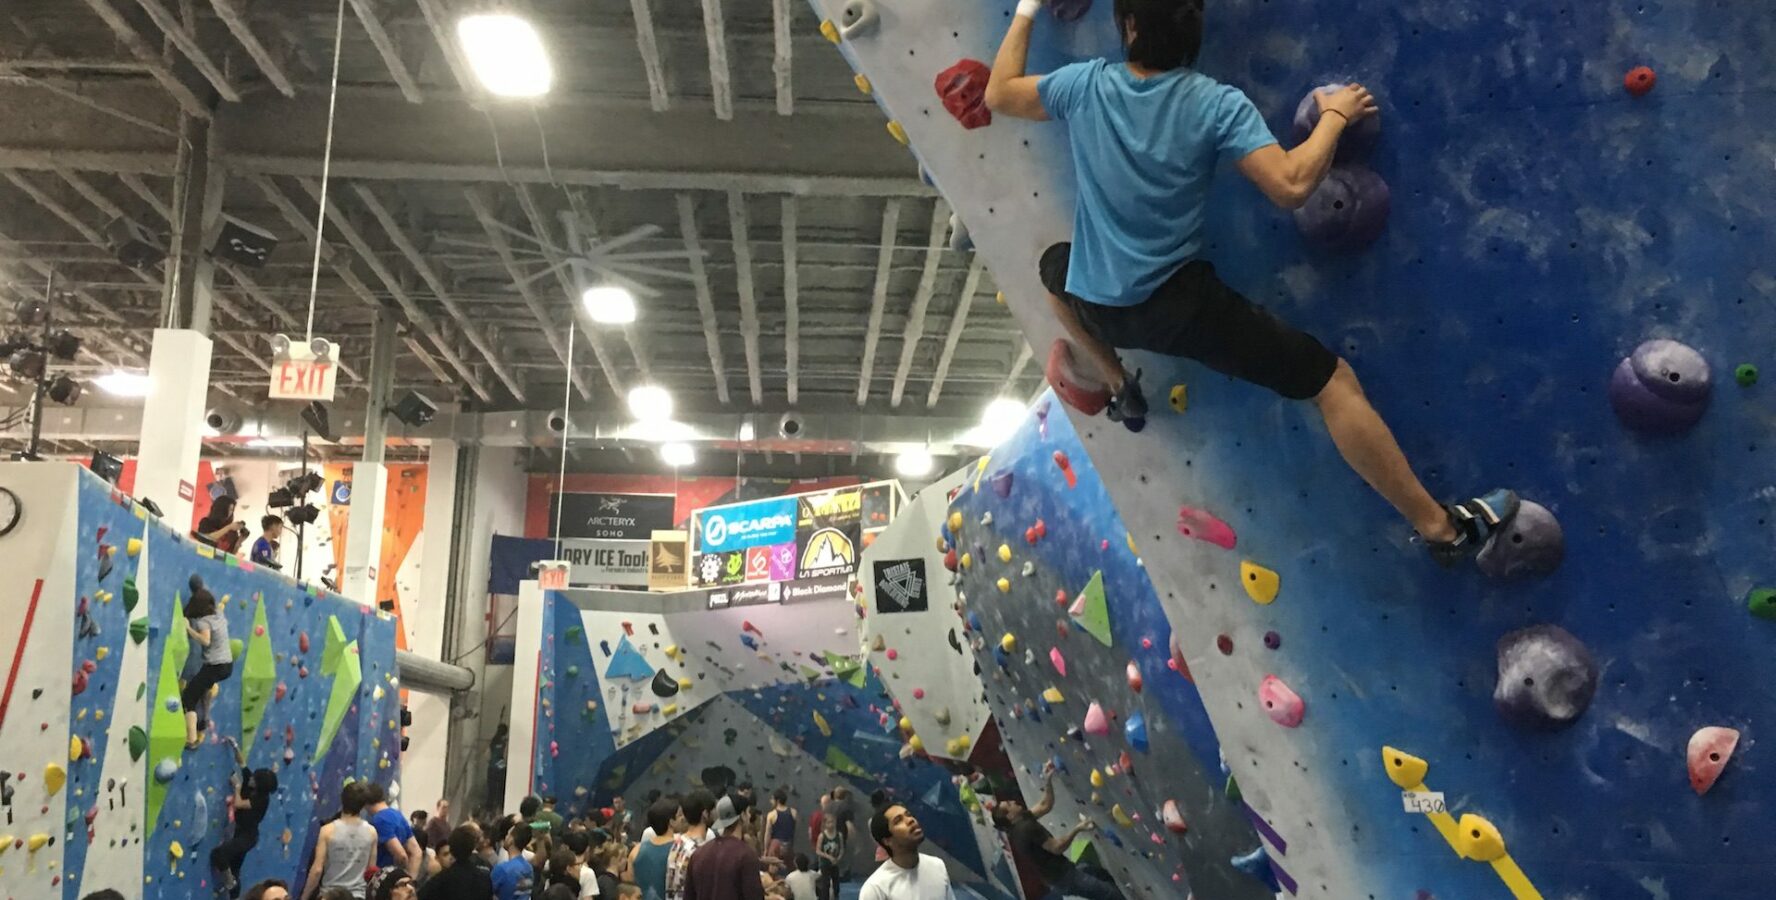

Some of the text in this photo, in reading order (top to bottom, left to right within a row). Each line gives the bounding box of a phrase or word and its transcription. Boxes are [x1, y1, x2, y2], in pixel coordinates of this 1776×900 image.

[279, 362, 330, 395] EXIT
[728, 515, 792, 535] SCARPA
[564, 548, 592, 566] DRY
[595, 550, 615, 567] ICE
[800, 565, 853, 578] LA SPORTIVA
[793, 582, 846, 596] Black Diamond
